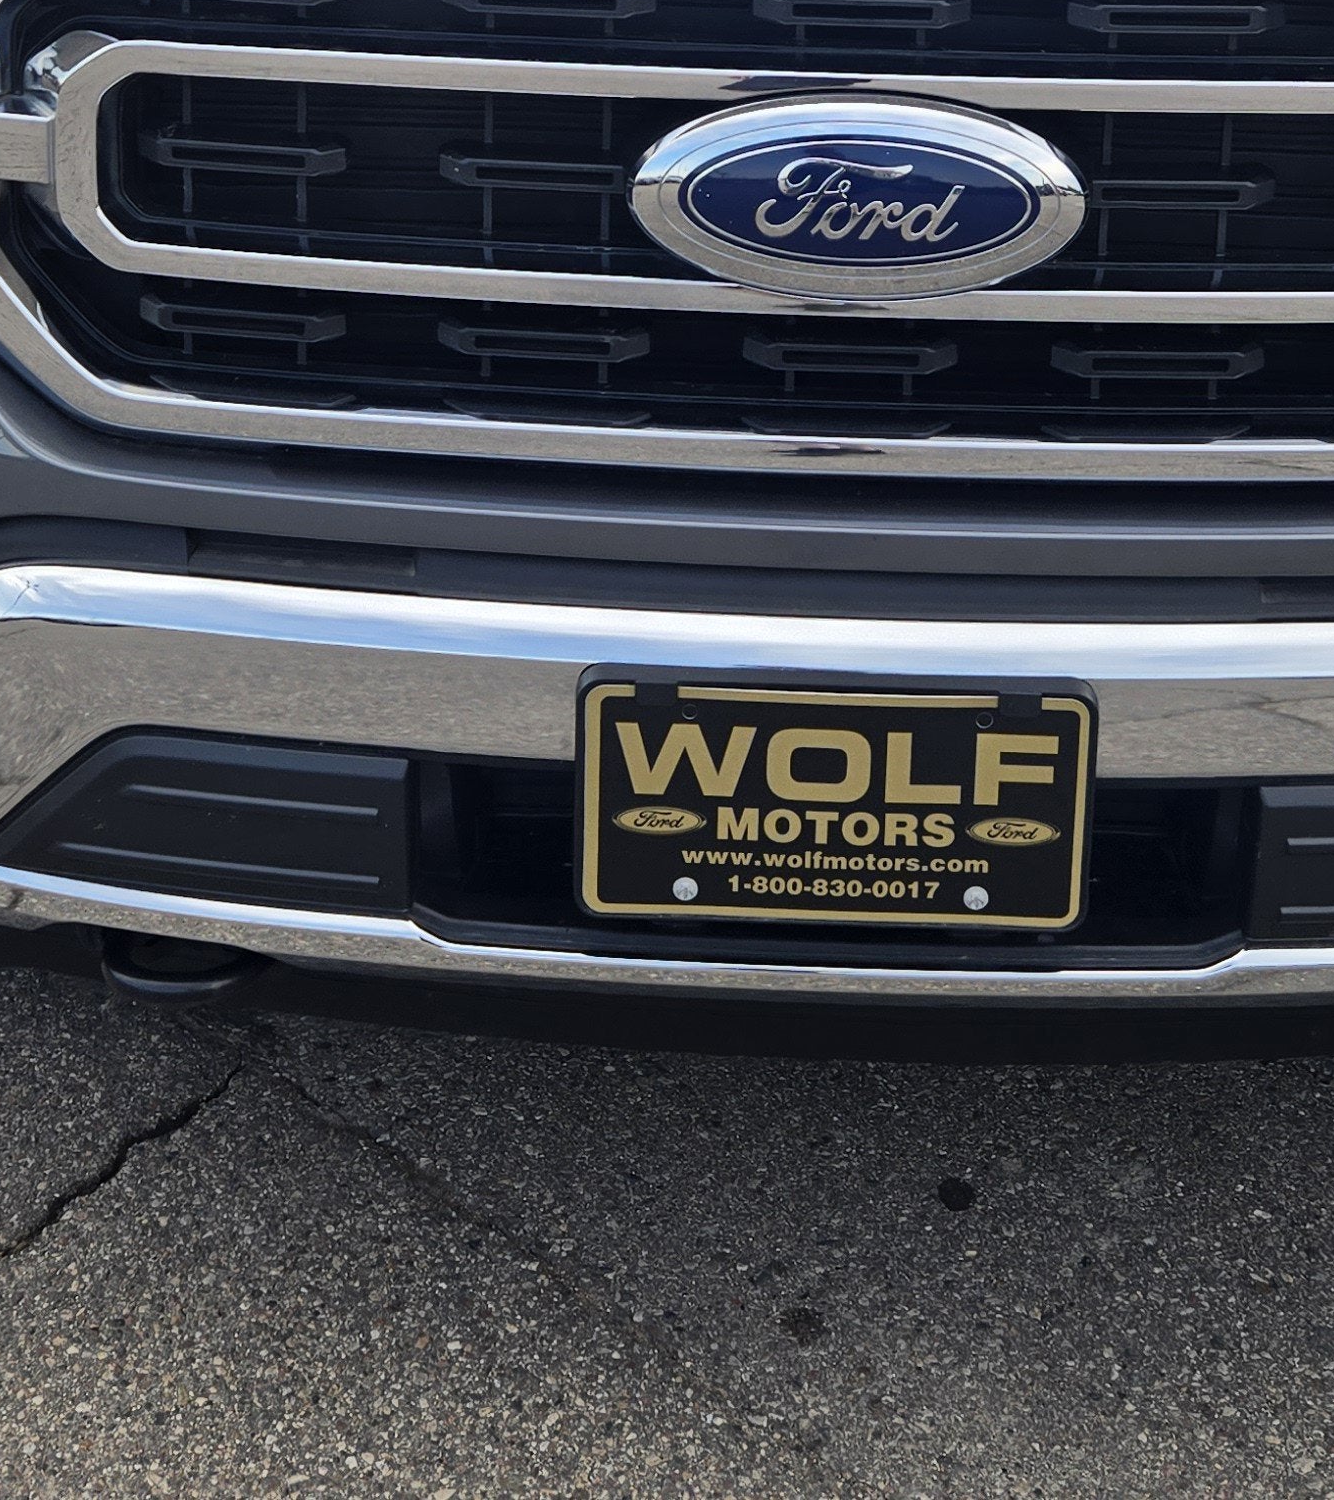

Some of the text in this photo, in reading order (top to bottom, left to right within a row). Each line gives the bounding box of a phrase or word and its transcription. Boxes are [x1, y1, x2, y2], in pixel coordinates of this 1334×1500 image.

[755, 156, 966, 242] Ford
[614, 722, 1059, 806] WOLF
[633, 809, 686, 830] Ford
[717, 806, 956, 848] MOTORS
[986, 821, 1038, 841] Ford
[681, 850, 990, 874] www.wolfmotors.com
[728, 874, 941, 900] 1-800-830-0017
